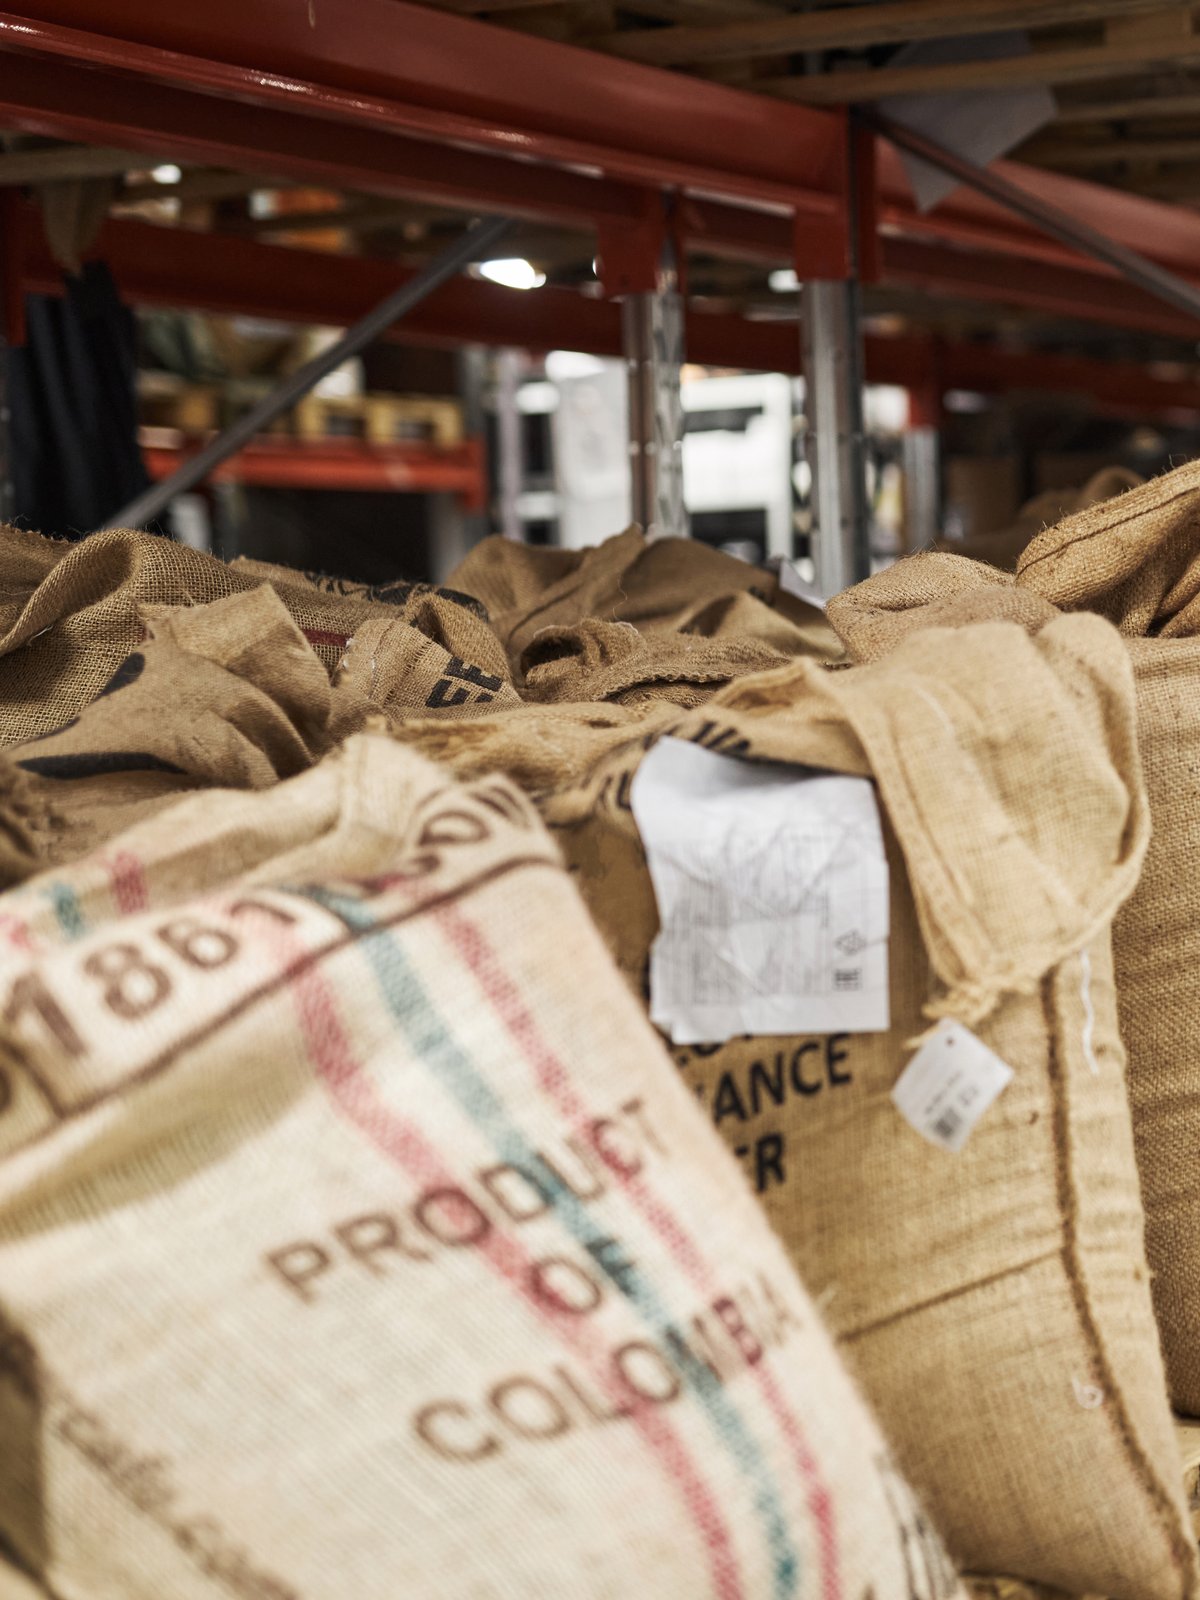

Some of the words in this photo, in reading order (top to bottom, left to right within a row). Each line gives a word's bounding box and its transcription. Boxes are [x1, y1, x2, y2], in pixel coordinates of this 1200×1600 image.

[696, 1031, 852, 1125] ANCE
[267, 1096, 669, 1305] PRODUCT
[527, 1236, 637, 1316] OF
